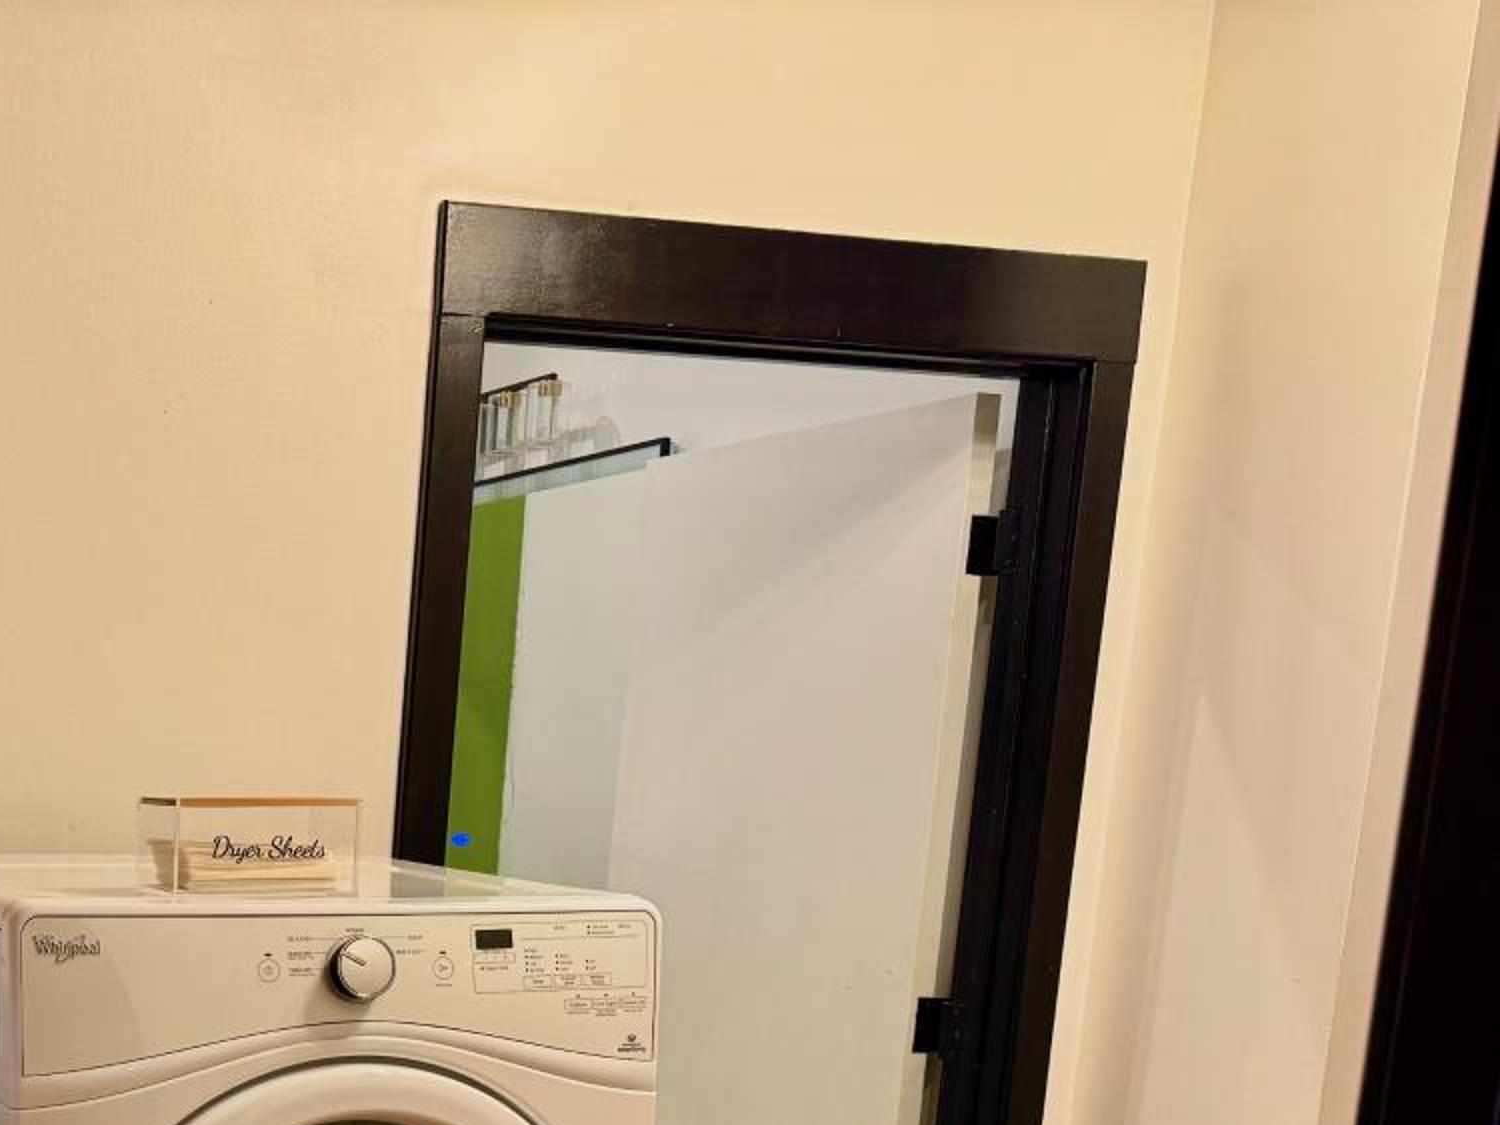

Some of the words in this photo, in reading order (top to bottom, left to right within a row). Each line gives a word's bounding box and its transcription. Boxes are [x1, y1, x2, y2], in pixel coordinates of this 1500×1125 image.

[212, 835, 262, 864] Dryer
[268, 835, 325, 859] Sheets
[32, 934, 101, 964] Whirlpool
